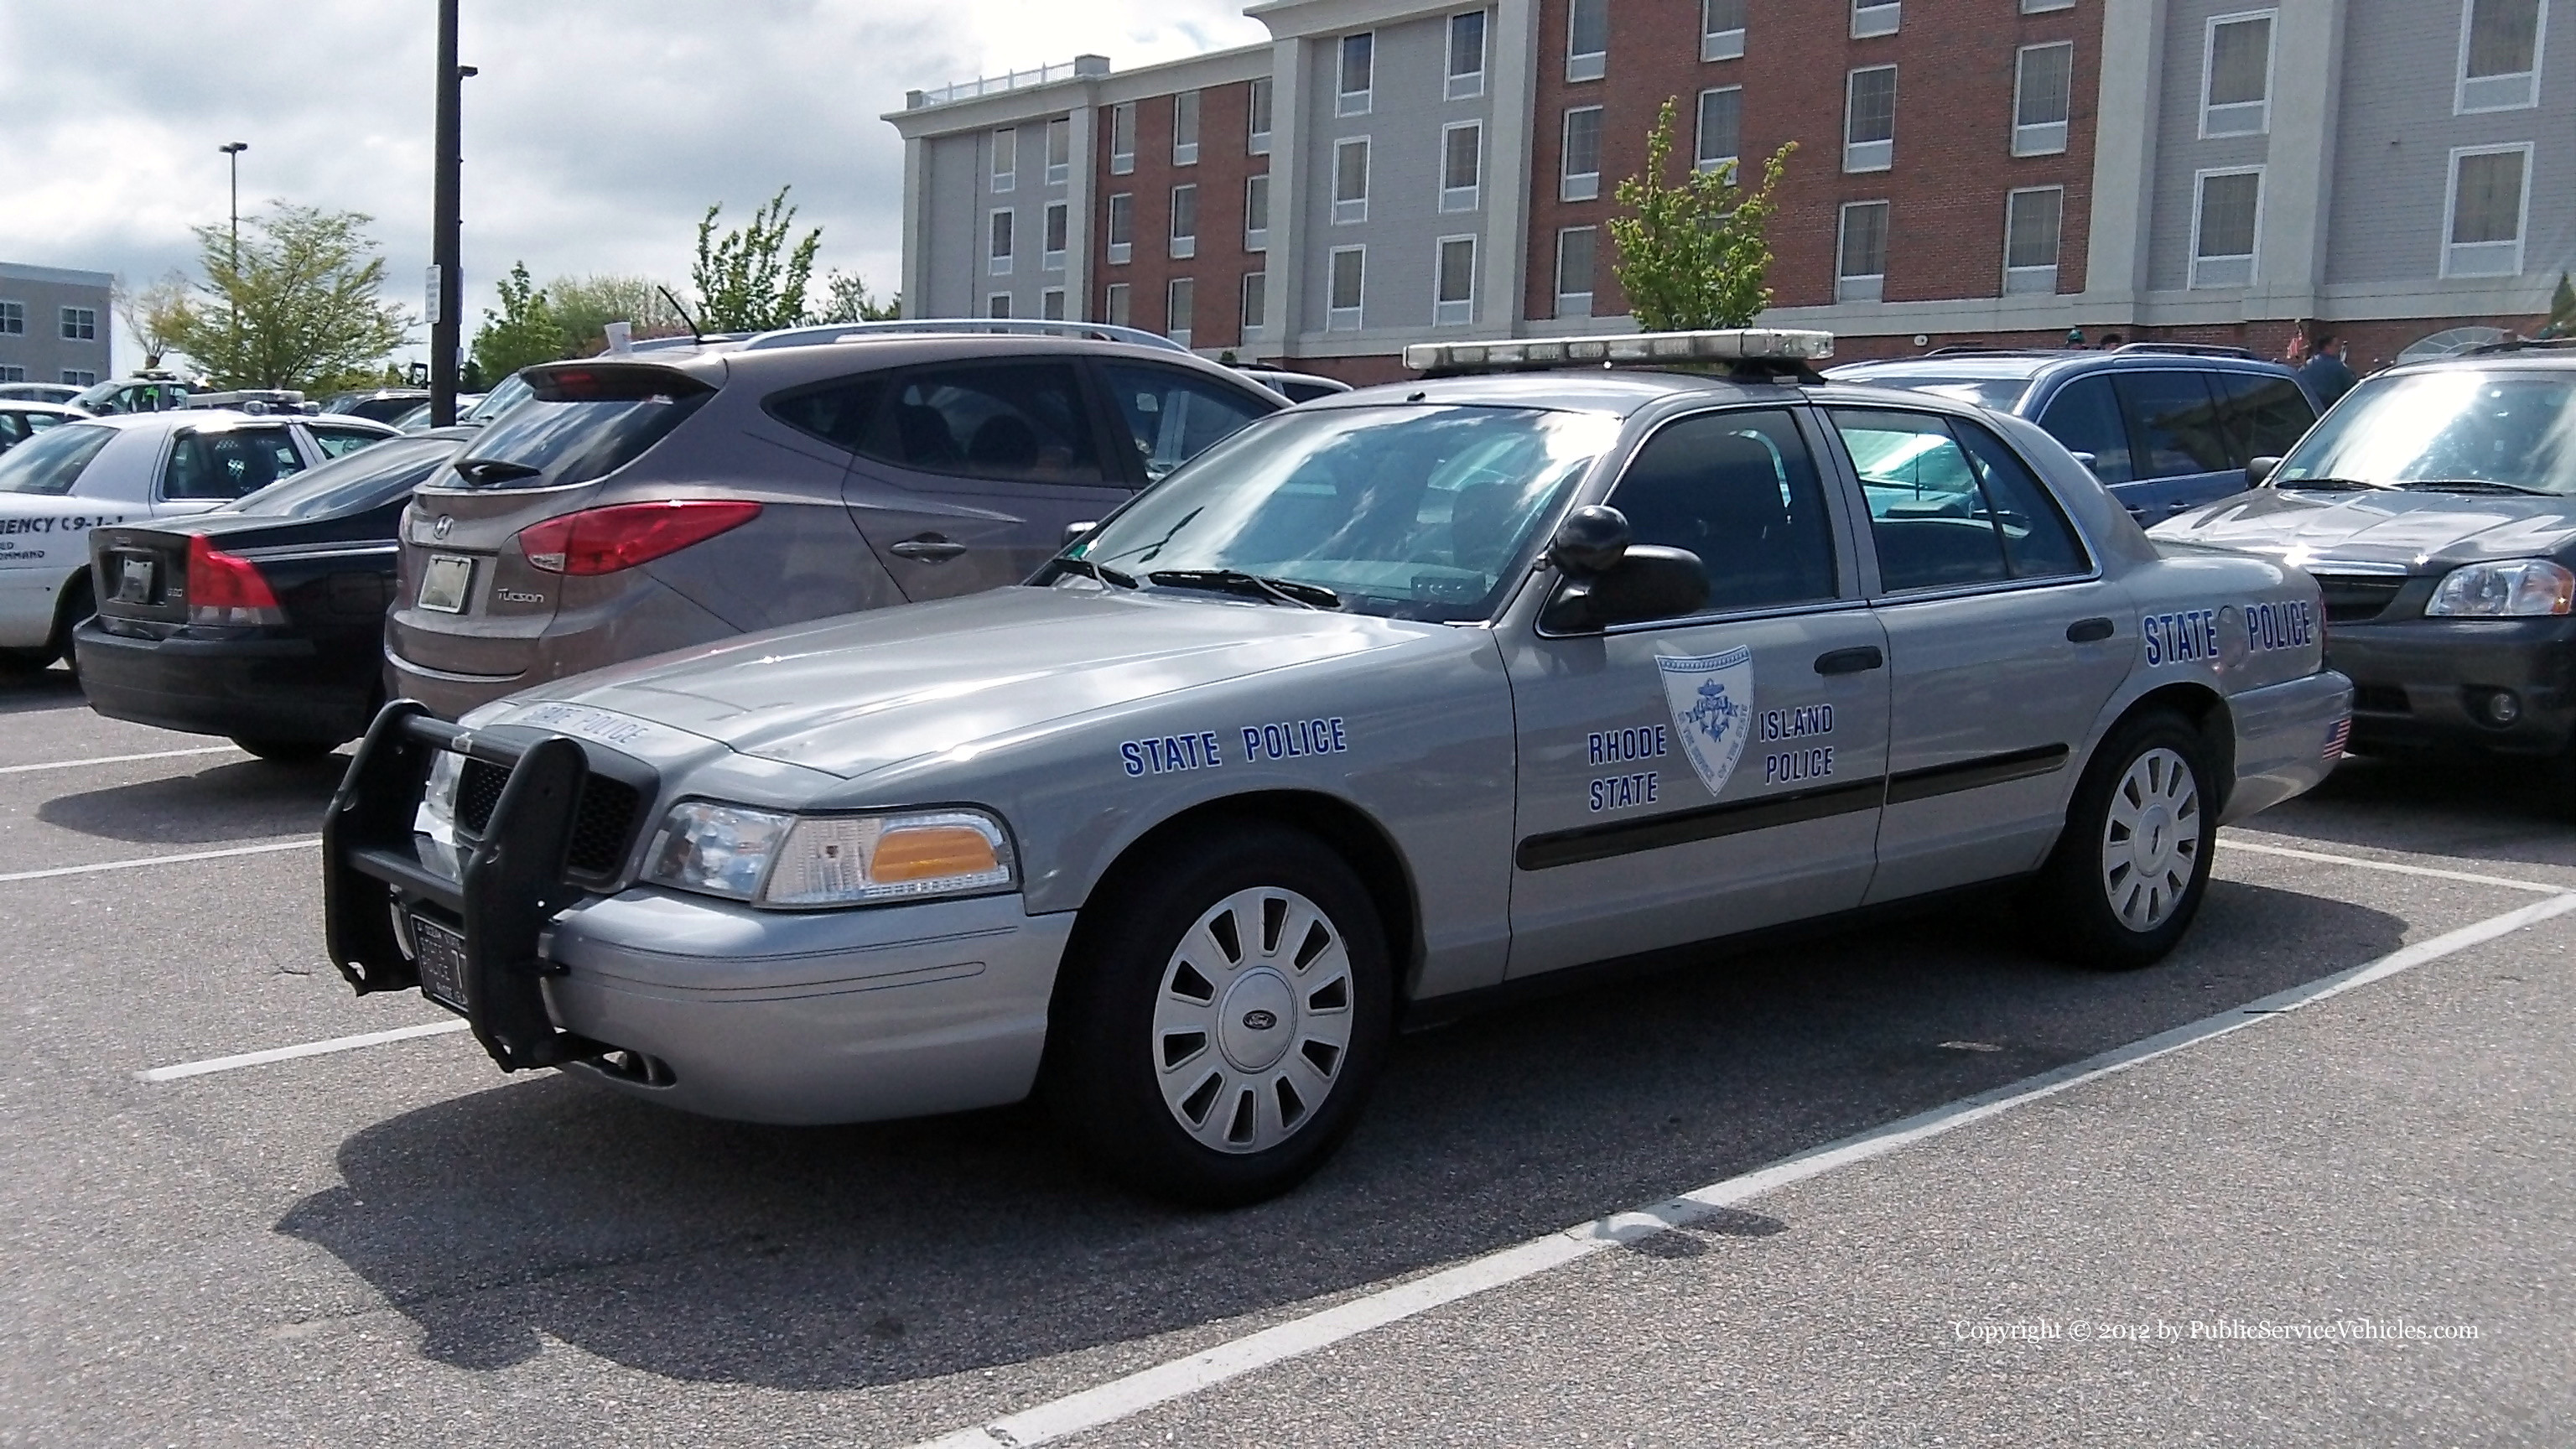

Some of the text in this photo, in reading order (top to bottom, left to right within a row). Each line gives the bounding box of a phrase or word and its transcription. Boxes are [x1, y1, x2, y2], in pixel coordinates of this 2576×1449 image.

[497, 588, 544, 603] Tucson
[2142, 600, 2312, 668] STATE POLICE
[572, 712, 650, 744] POLICE
[1120, 717, 1348, 777] STATE POLICE
[1587, 724, 1667, 766] RHODE
[1759, 704, 1834, 743] ISLAND
[1589, 771, 1659, 813] STATE
[1765, 746, 1834, 786] POLICE
